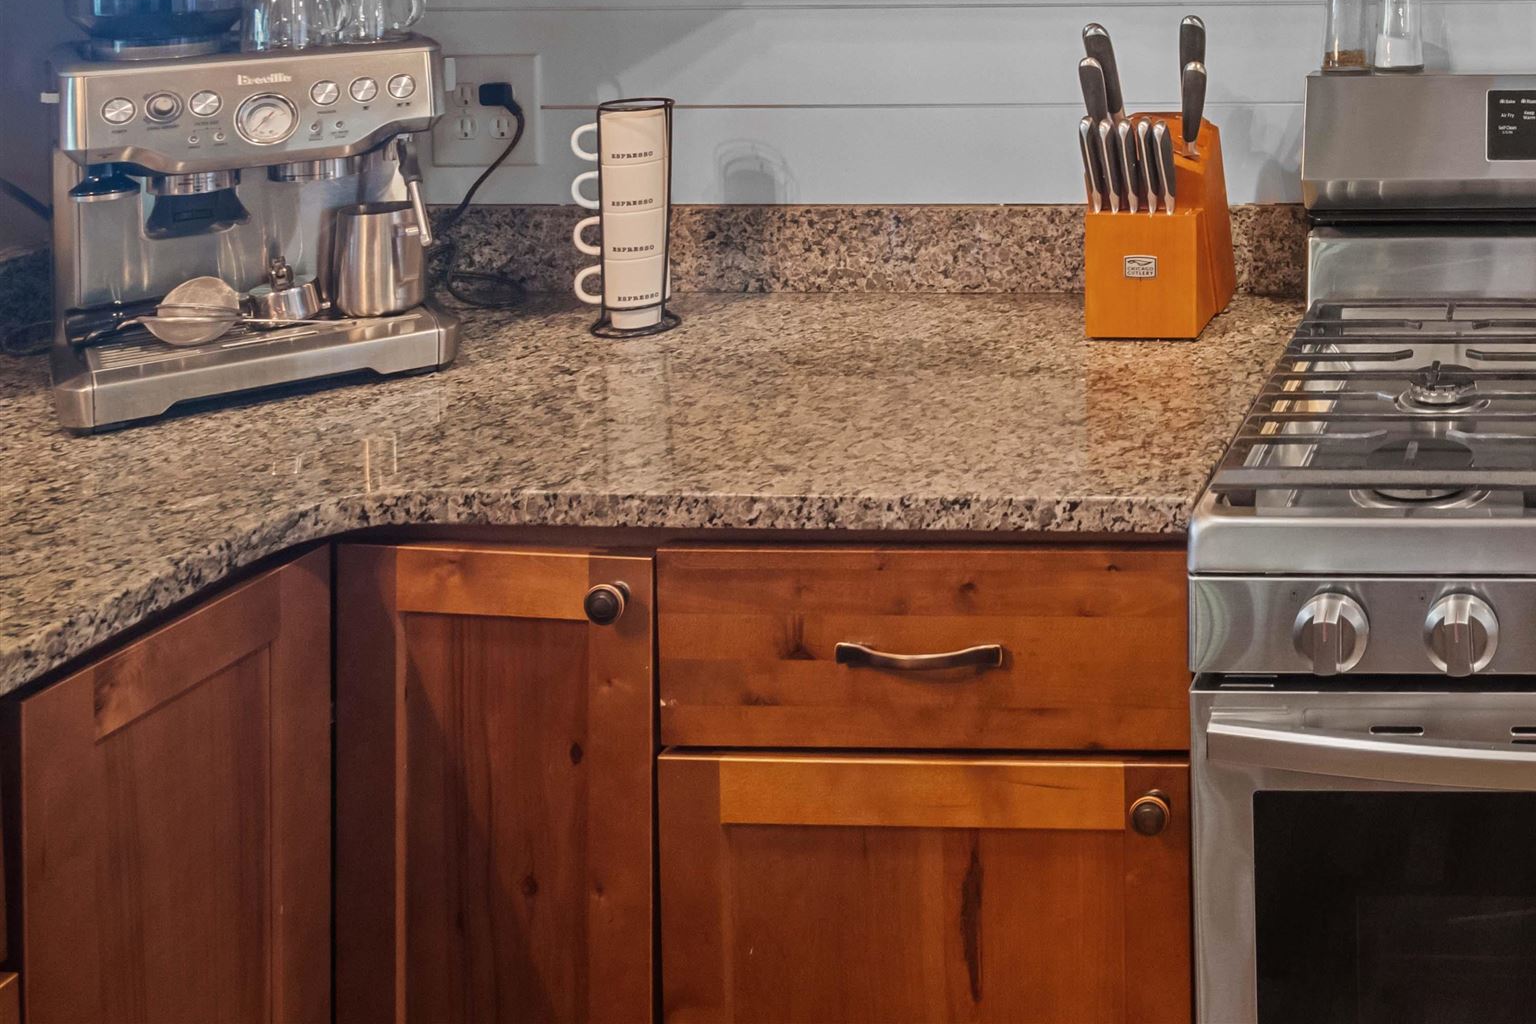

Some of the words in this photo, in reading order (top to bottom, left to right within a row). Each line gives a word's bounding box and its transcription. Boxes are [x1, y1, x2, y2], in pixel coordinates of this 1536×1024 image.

[612, 151, 654, 159] ESPRESSO
[612, 198, 654, 207] ESPRESSO
[612, 244, 655, 253] ESPRESSO
[618, 292, 659, 302] ESPRESSO
